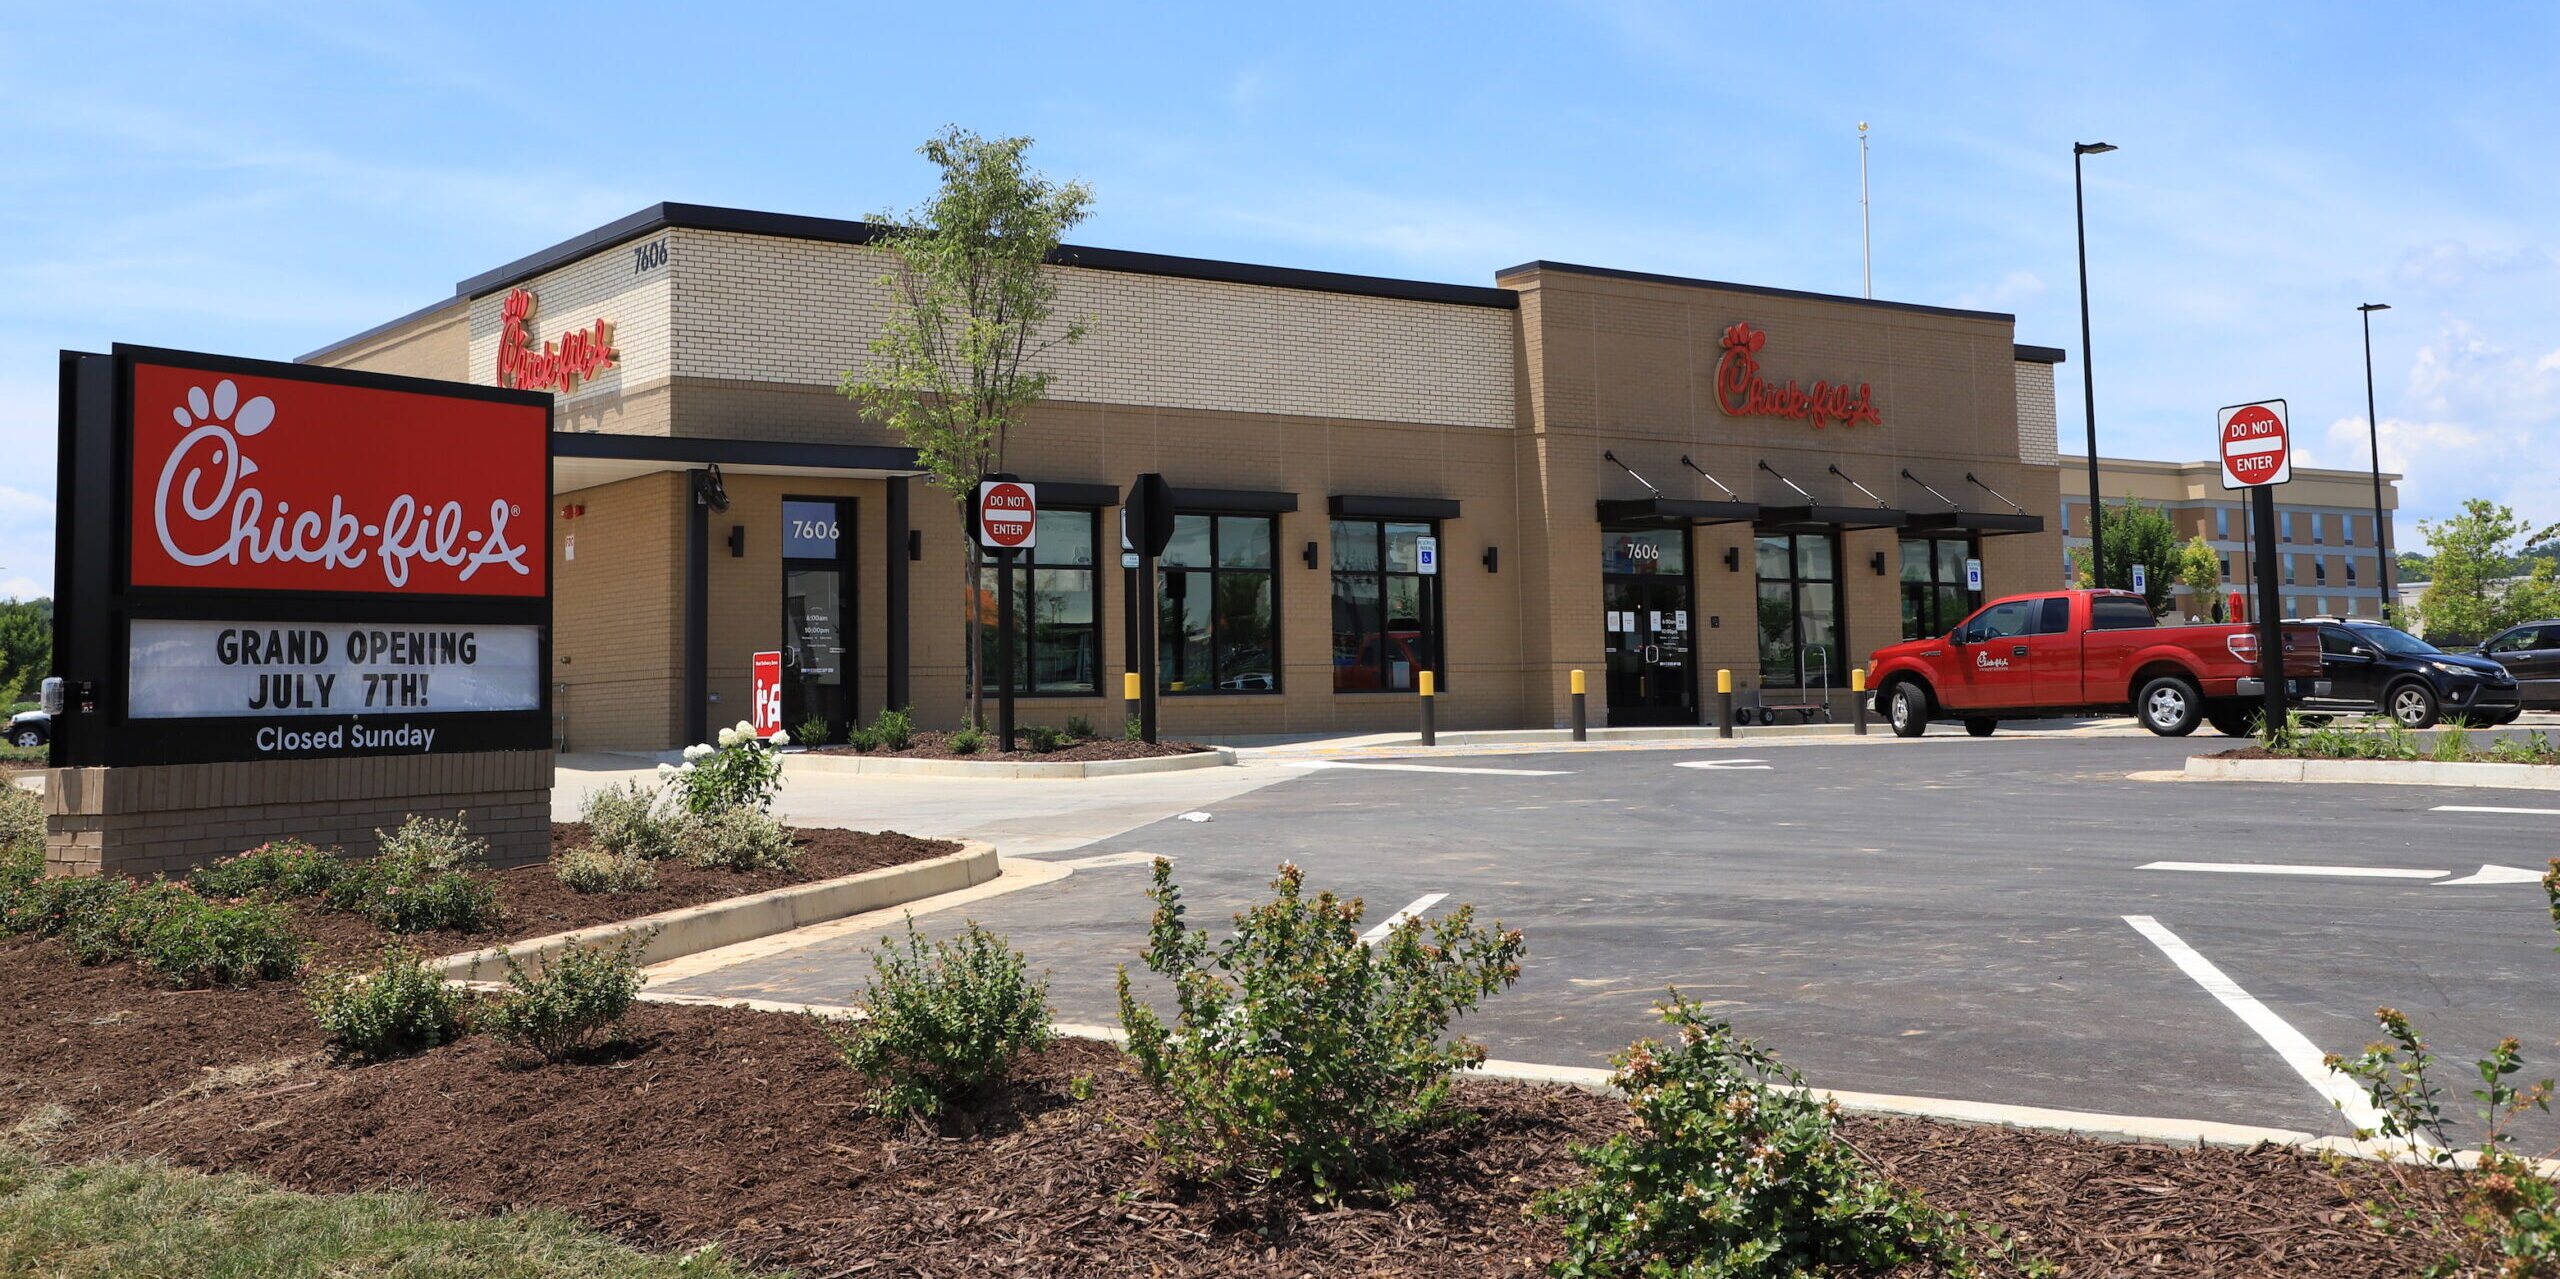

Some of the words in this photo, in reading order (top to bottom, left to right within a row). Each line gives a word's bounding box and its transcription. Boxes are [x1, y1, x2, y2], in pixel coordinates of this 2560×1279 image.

[634, 237, 668, 275] 7606
[1716, 345, 1882, 430] Chick-fil-A
[2231, 423, 2247, 438] DO
[2252, 420, 2274, 435] NOT
[2237, 455, 2273, 472] ENTER
[990, 495, 1003, 506] DO
[1007, 496, 1026, 507] NOT
[792, 520, 840, 540] 7606
[993, 523, 1023, 535] ENTER
[1627, 543, 1659, 560] 7606
[216, 628, 330, 666] GRAND
[346, 631, 477, 665] OPENING
[248, 673, 336, 710] JULY
[362, 673, 430, 707] 7TH!
[256, 724, 343, 751] Closed
[350, 722, 436, 752] Sunday
